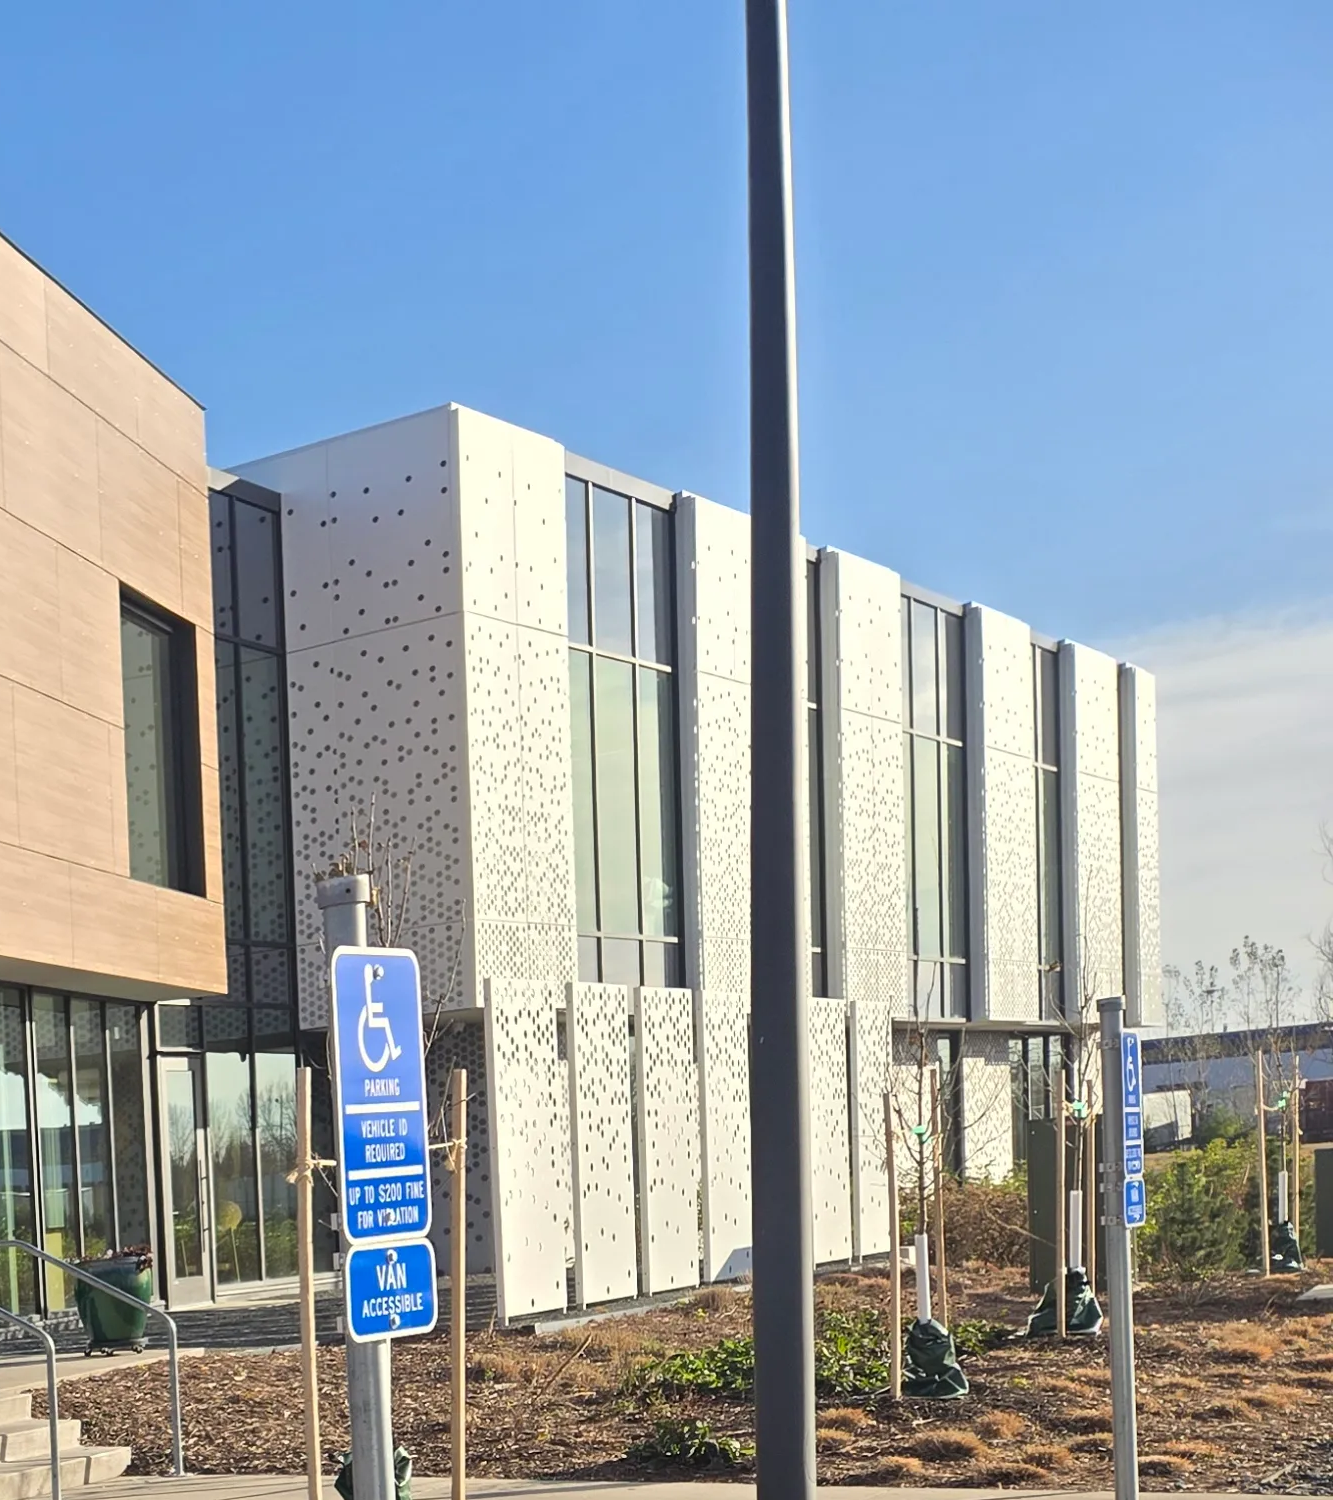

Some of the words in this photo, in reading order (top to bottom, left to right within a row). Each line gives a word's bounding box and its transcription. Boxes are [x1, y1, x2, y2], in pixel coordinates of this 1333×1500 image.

[364, 1077, 401, 1097] PARKING
[360, 1118, 396, 1139] VEHICLE
[398, 1117, 409, 1136] ID
[364, 1142, 406, 1163] REQUIRED
[349, 1186, 361, 1206] UP
[364, 1184, 375, 1204] TO
[405, 1180, 425, 1200] FINE
[357, 1209, 374, 1230] FOR
[376, 1205, 419, 1228] VILATION
[376, 1262, 407, 1291] VAN
[362, 1292, 424, 1319] ACCESSIBLE
